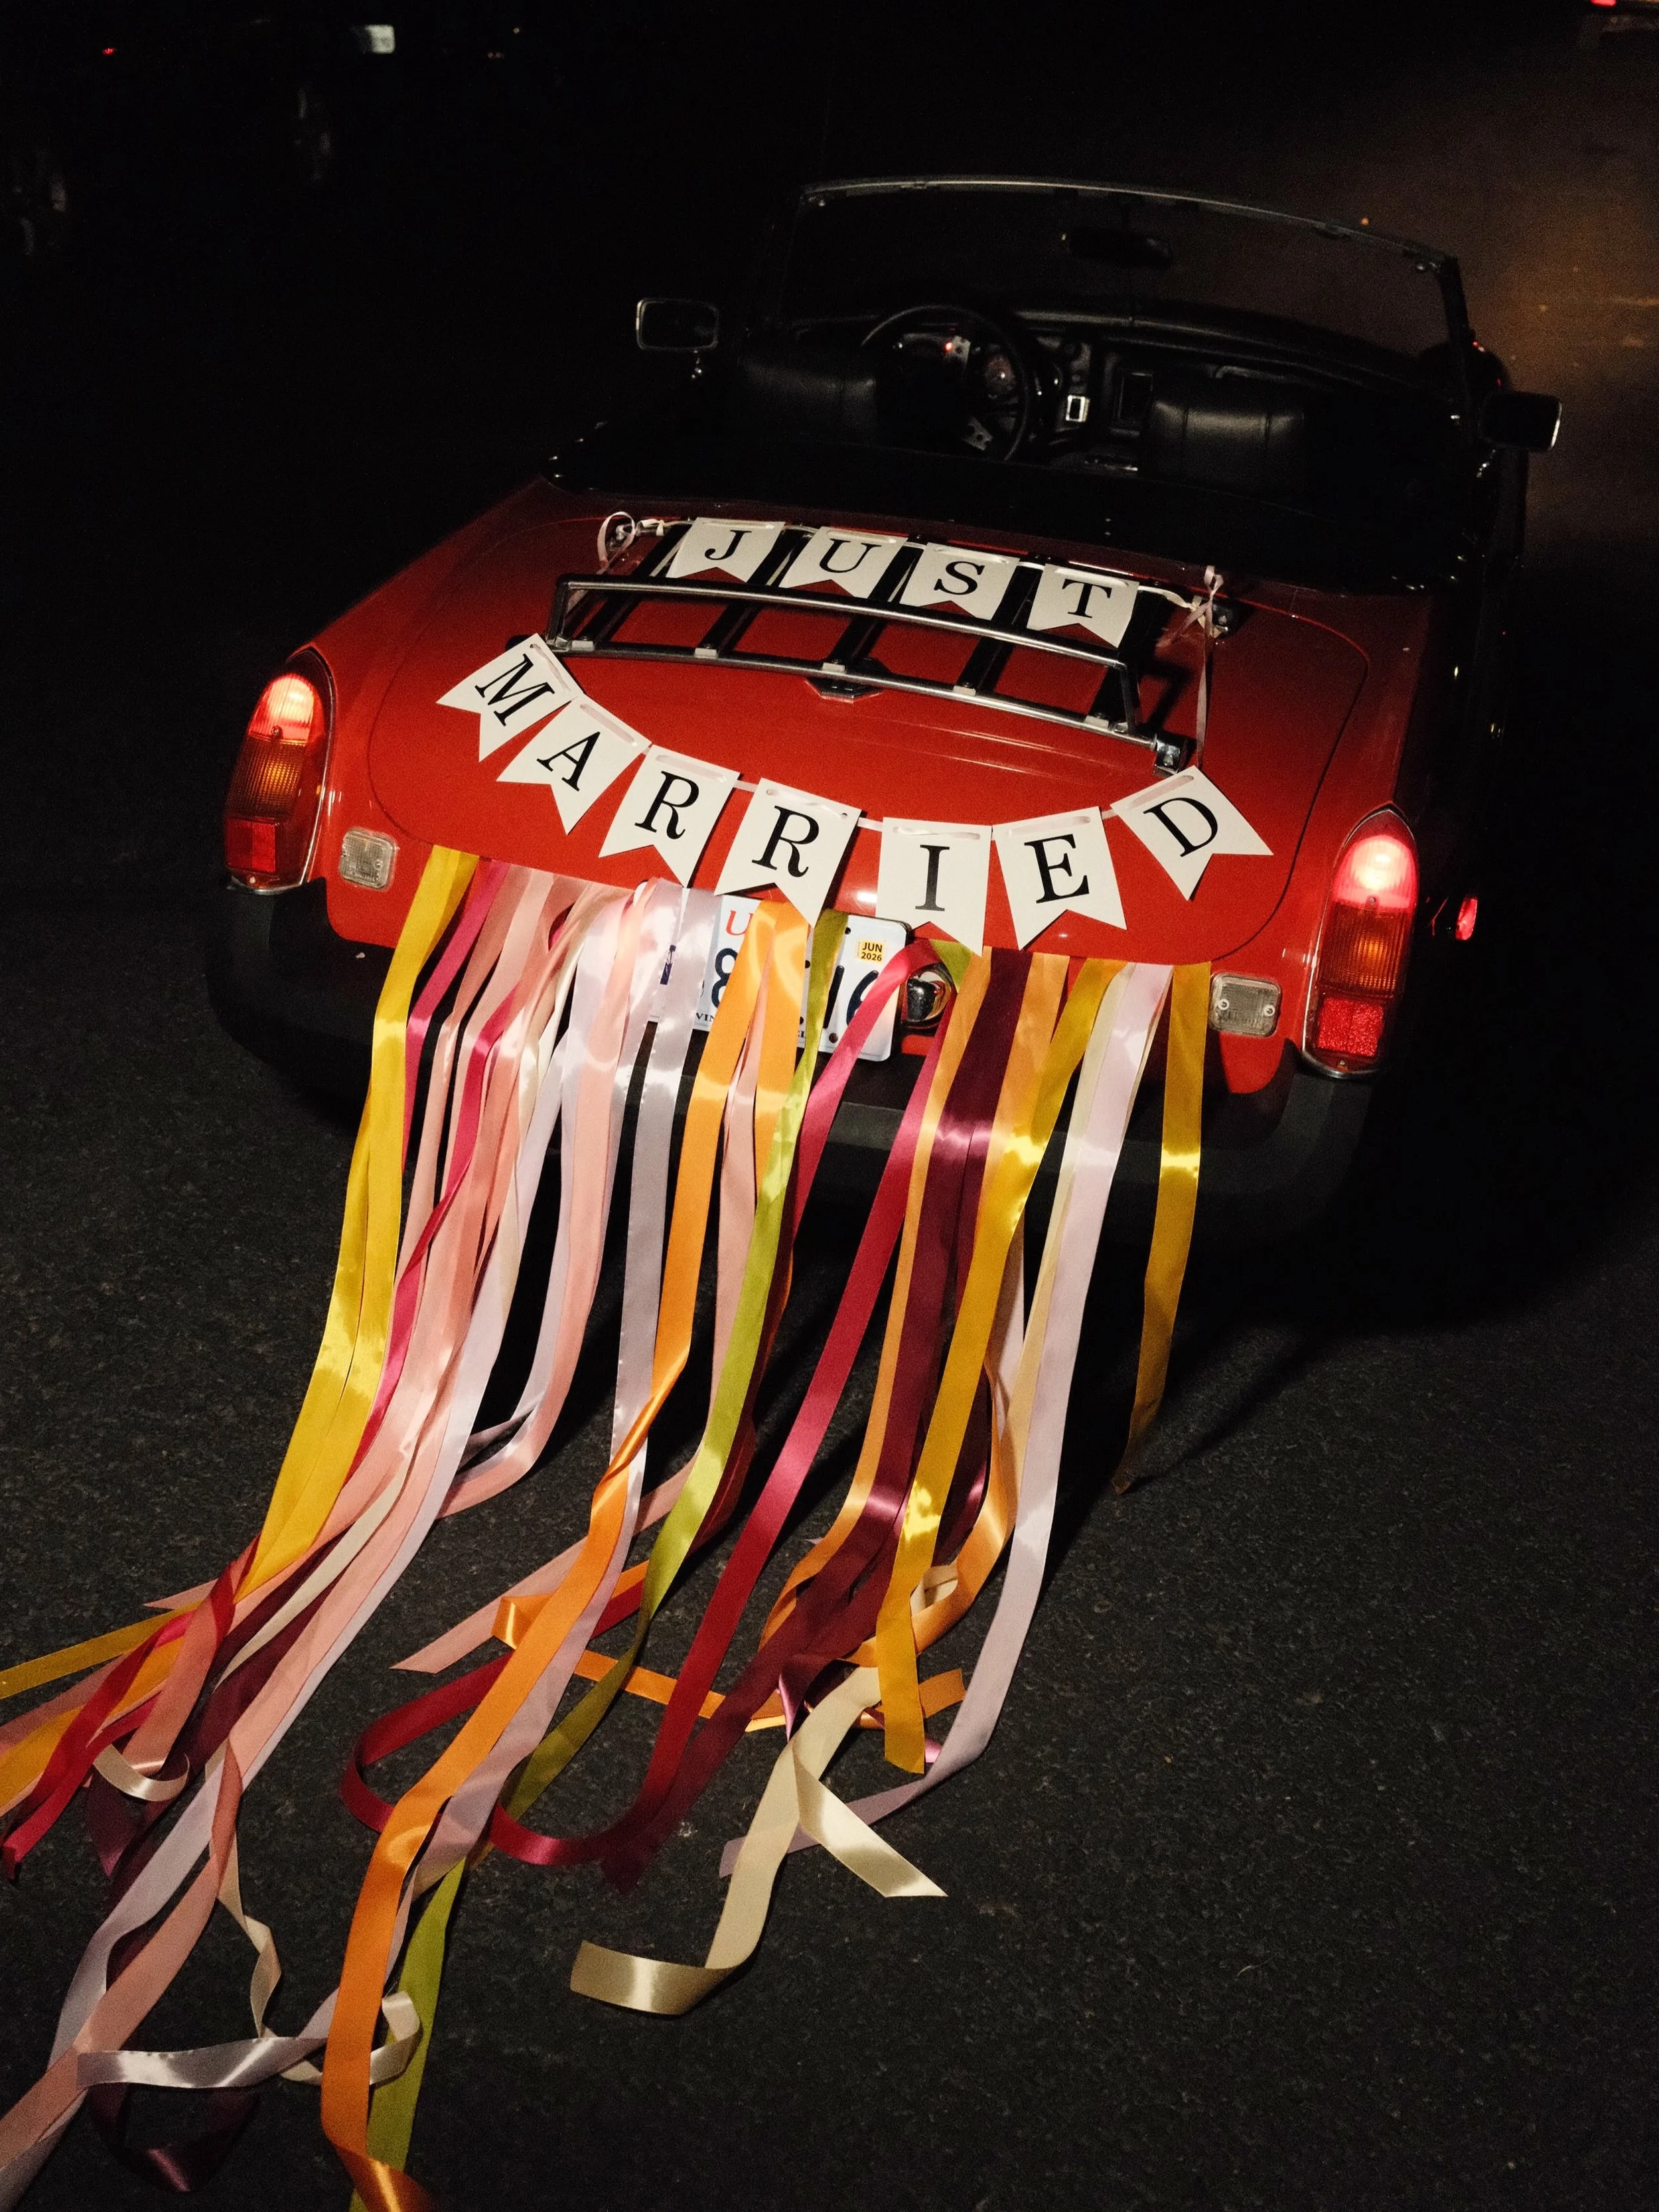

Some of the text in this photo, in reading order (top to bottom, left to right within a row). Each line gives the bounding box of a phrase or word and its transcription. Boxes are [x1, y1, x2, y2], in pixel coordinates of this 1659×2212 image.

[703, 529, 1112, 619] JUST
[474, 653, 1220, 913] MARRIED
[861, 952, 882, 962] 2026
[862, 942, 883, 952] JUN
